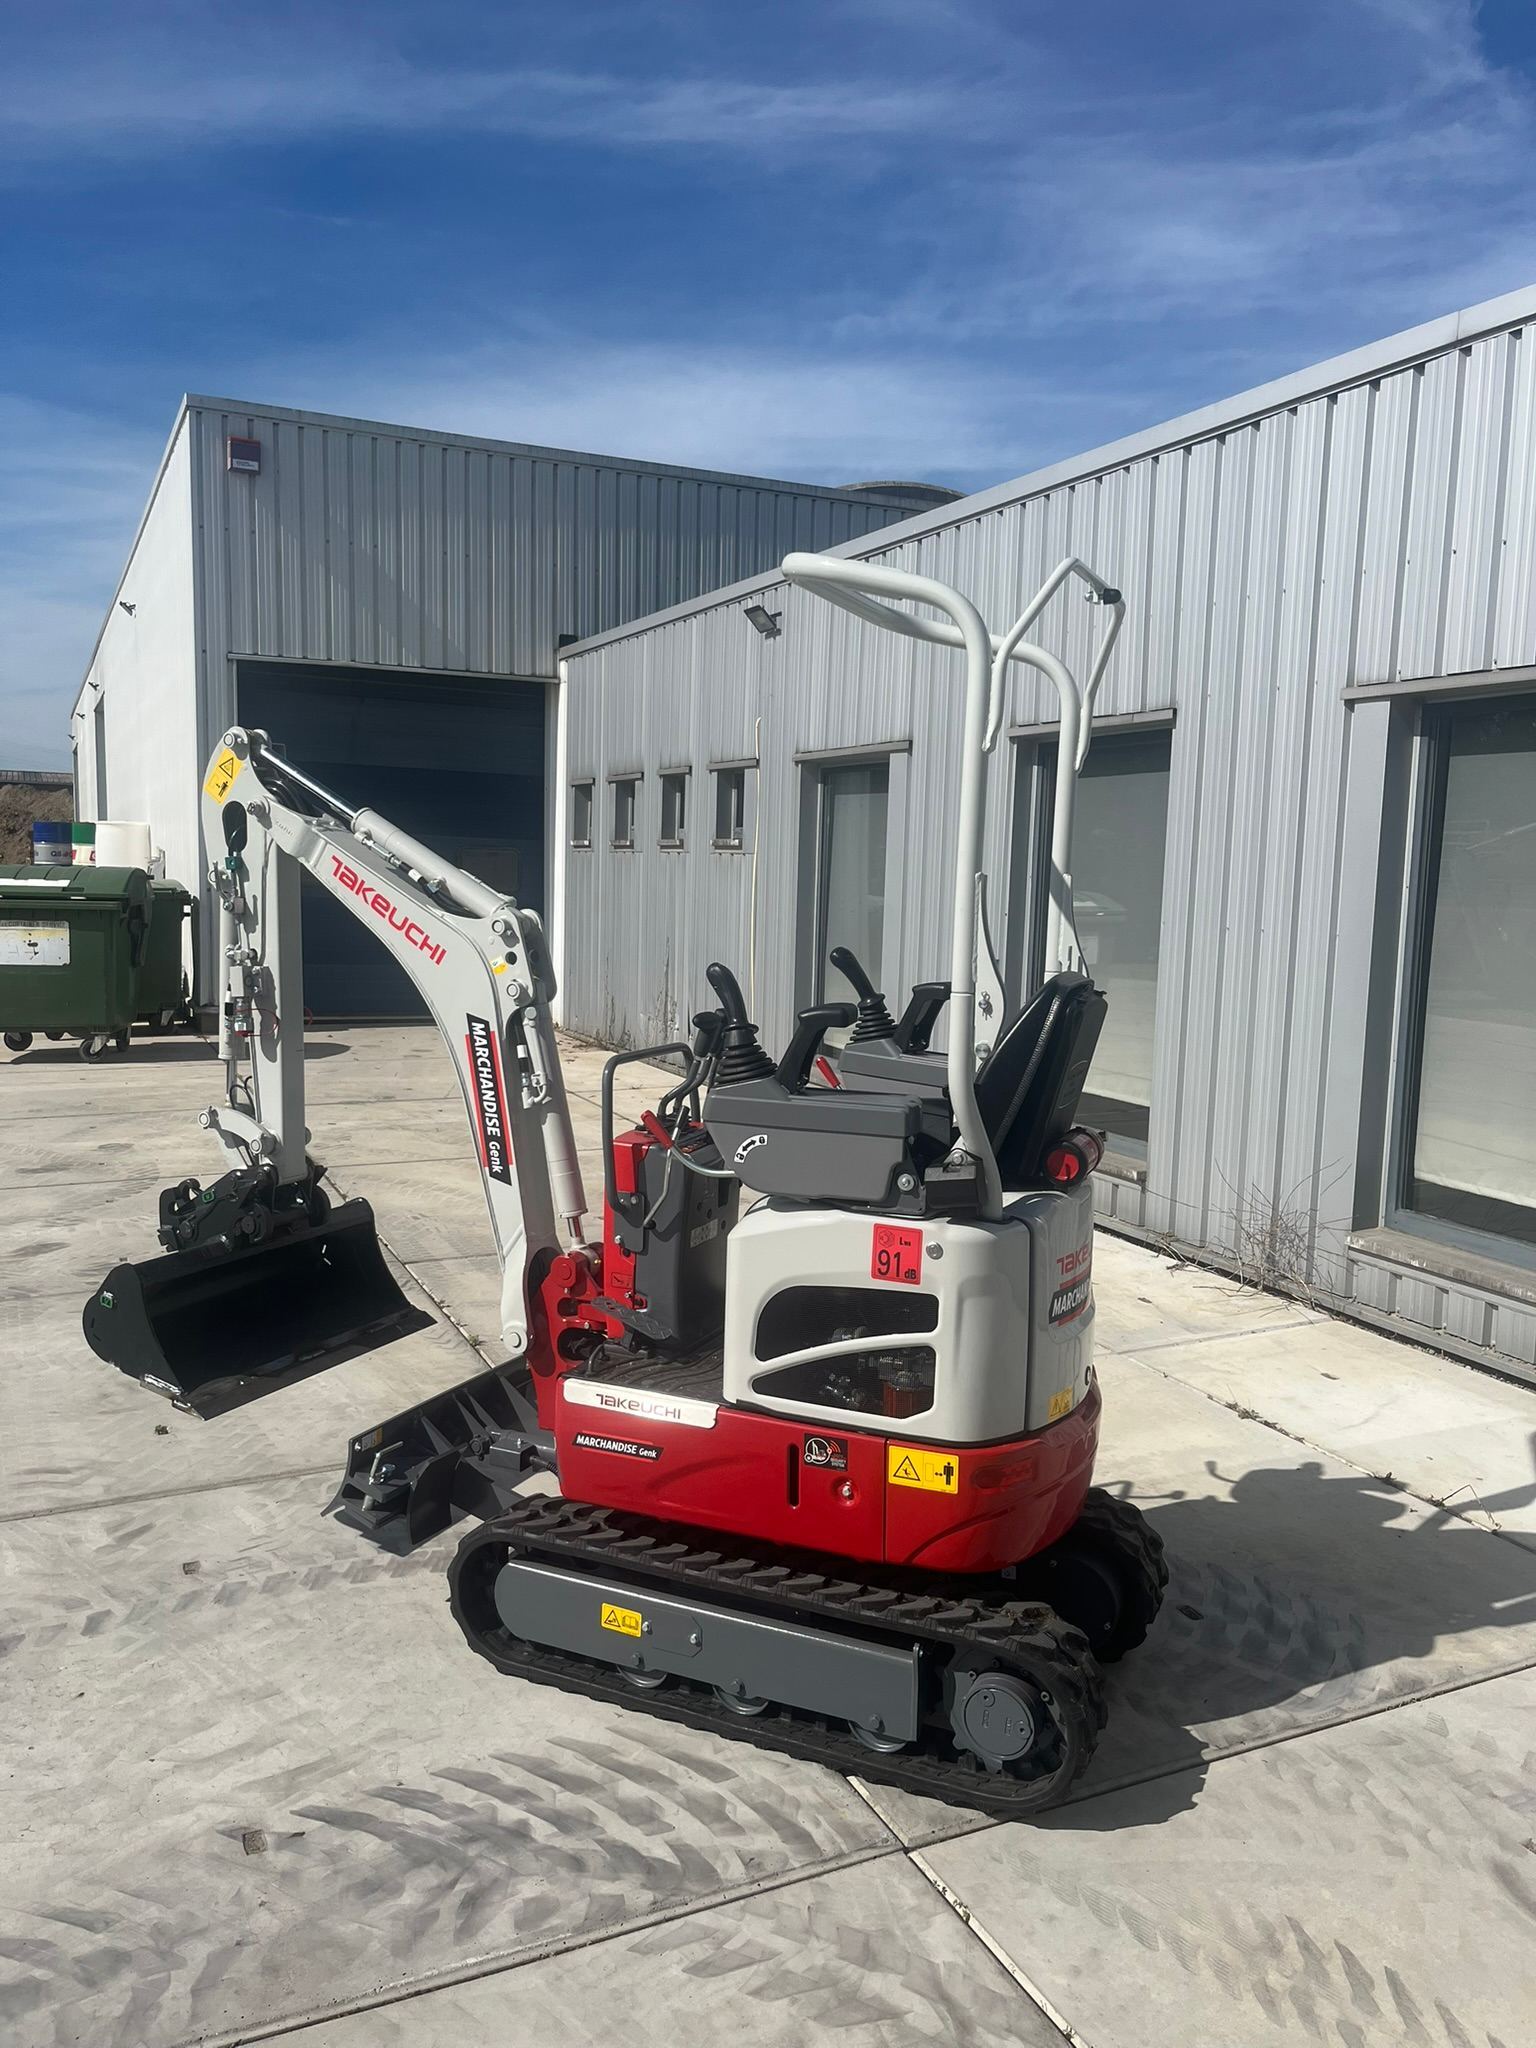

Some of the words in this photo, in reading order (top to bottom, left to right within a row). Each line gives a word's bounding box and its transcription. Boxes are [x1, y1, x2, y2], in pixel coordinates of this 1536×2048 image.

[331, 854, 447, 965] TAKEUCHI
[471, 1021, 501, 1137] MARCHANDISE
[488, 1141, 503, 1174] Genk
[877, 1249, 901, 1278] 91
[904, 1268, 917, 1280] dB
[596, 1393, 681, 1419] TAKEUCHI
[576, 1434, 638, 1454] MARCHANDISE
[639, 1447, 658, 1458] Genk
